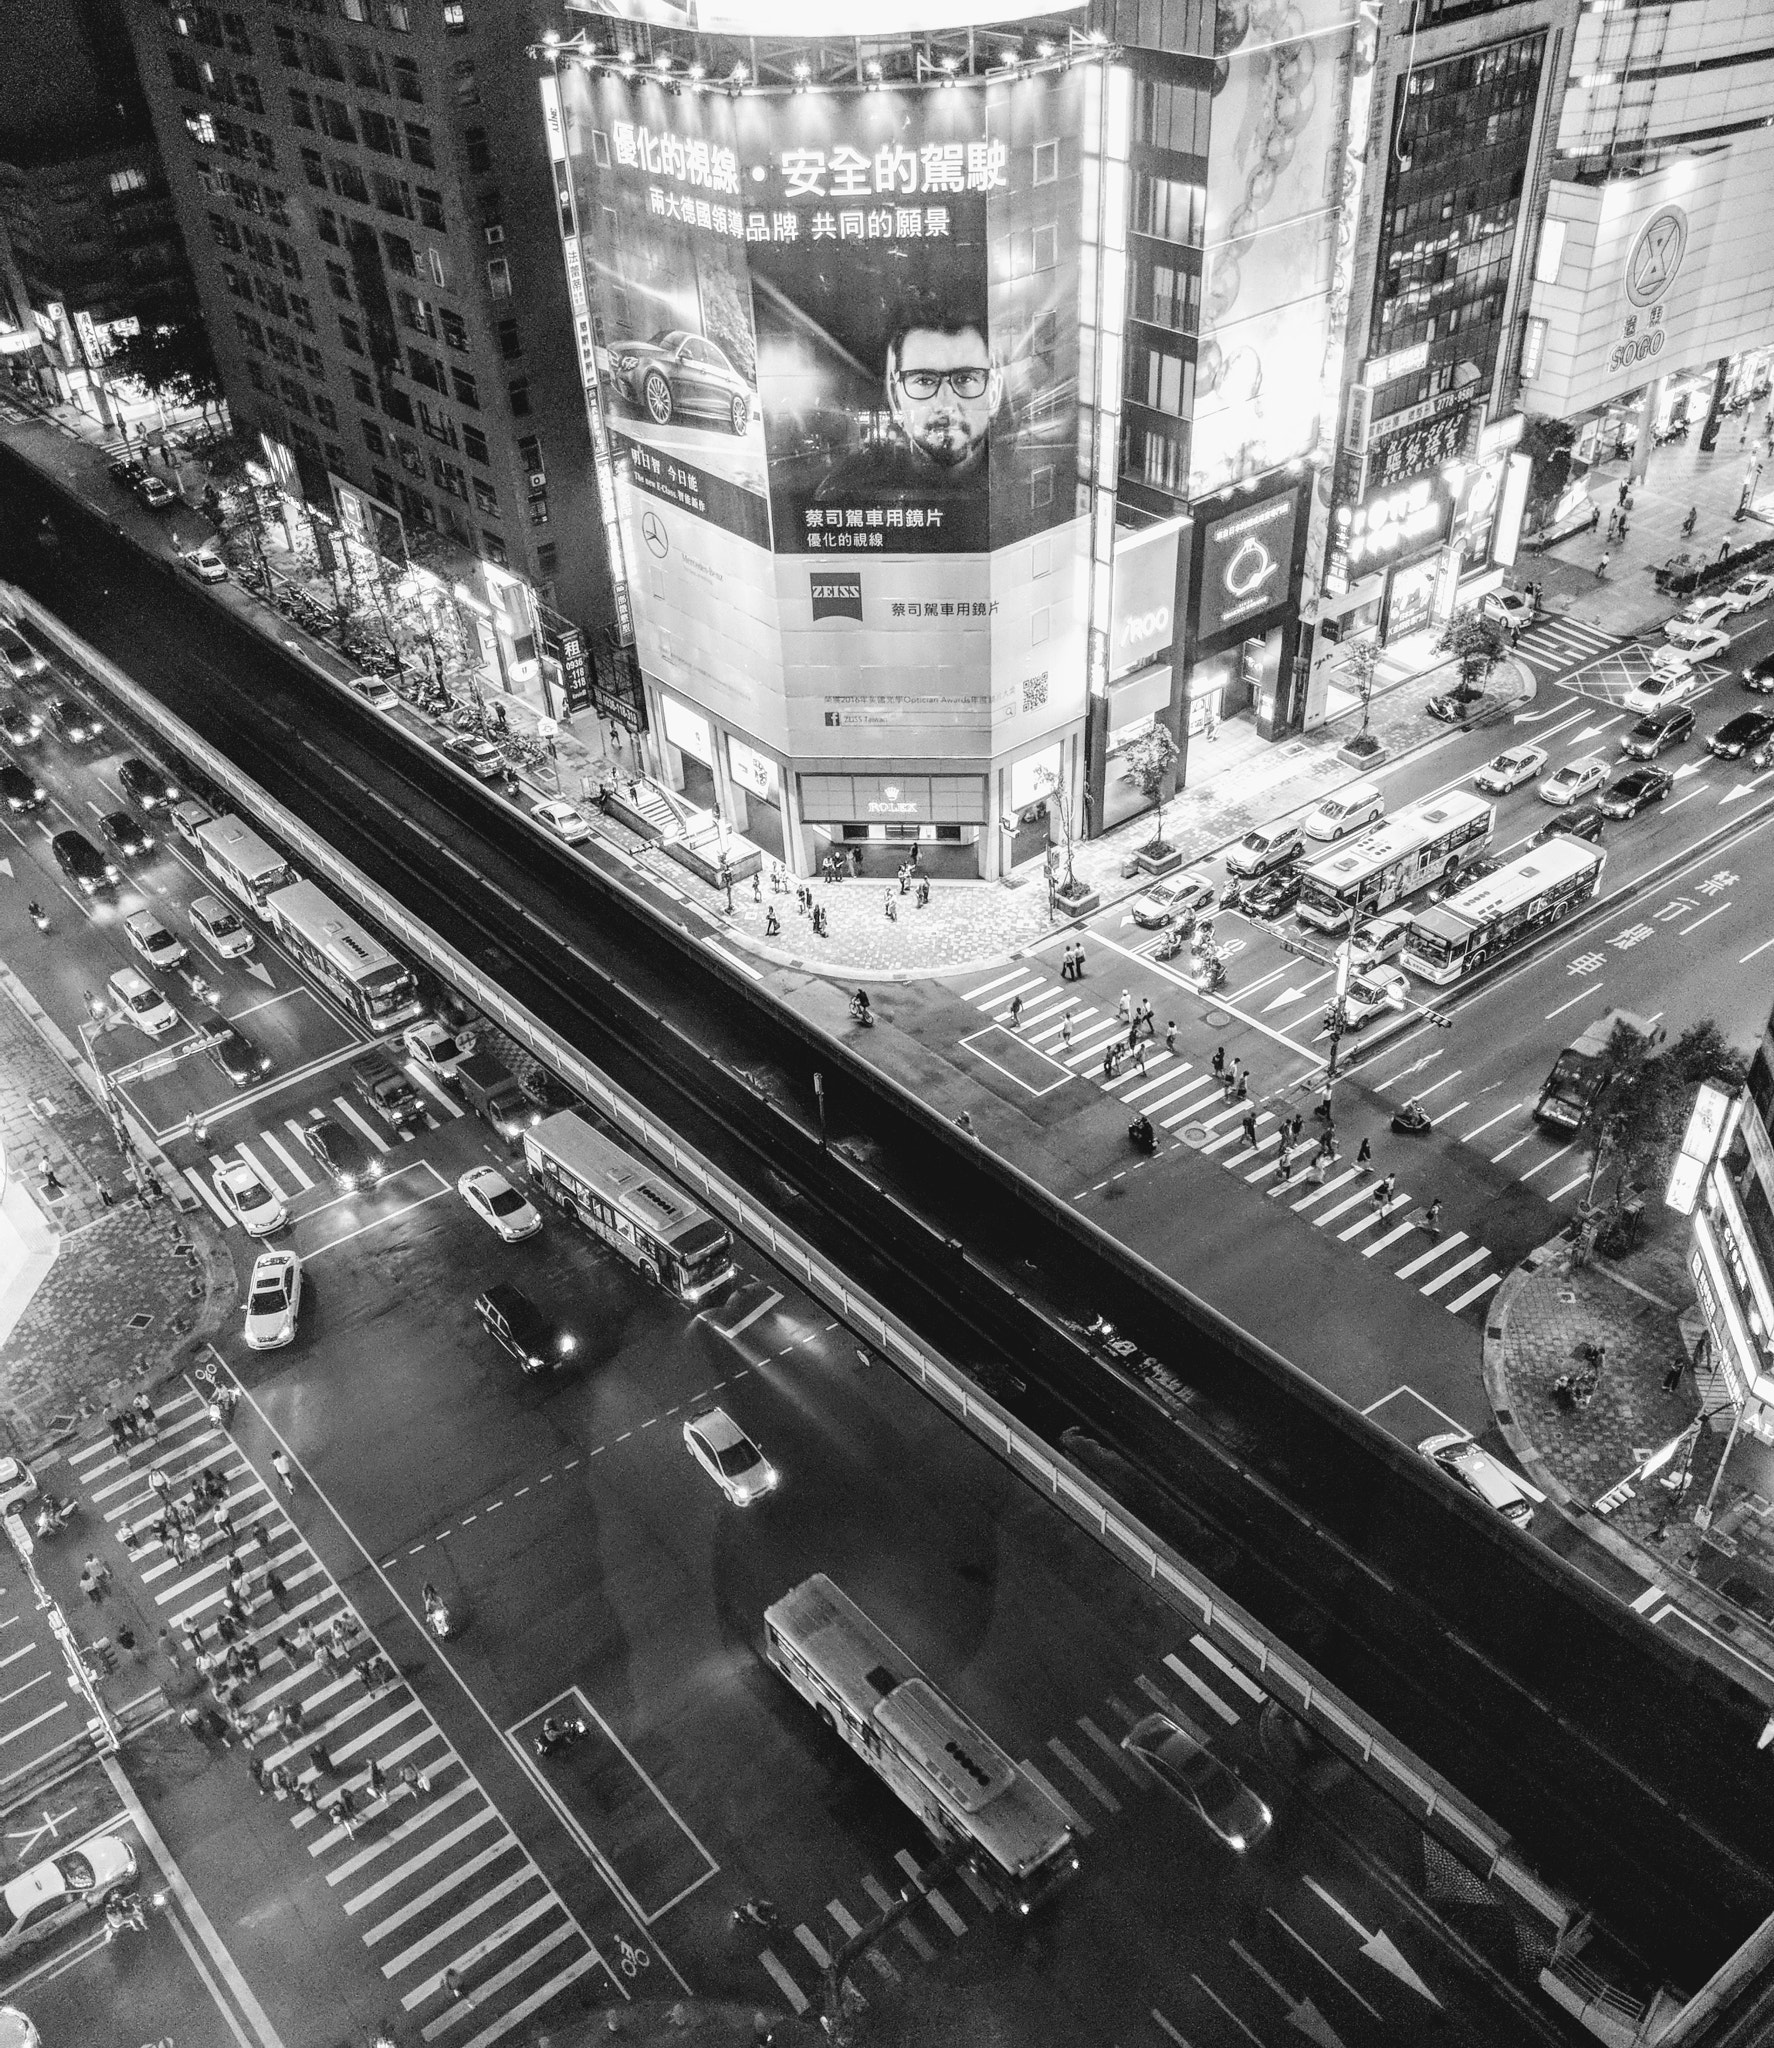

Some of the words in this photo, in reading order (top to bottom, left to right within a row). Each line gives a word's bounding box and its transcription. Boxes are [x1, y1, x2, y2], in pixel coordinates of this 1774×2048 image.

[613, 120, 739, 194] 優化的視線
[782, 140, 1006, 197] 安全的駕駛
[650, 187, 799, 241] 兩大德國領導品牌
[811, 208, 950, 241] 共同的願景
[1606, 330, 1665, 373] SOGO
[805, 509, 944, 528] 蔡司駕車用鏡片
[807, 533, 884, 547] 優化的視線
[812, 585, 861, 599] ZEISS
[891, 600, 1001, 617] 蔡司駕車用鏡片
[564, 640, 580, 657] 租
[566, 658, 584, 671] 0936
[570, 677, 587, 690] -318
[867, 802, 918, 813] ROLEX
